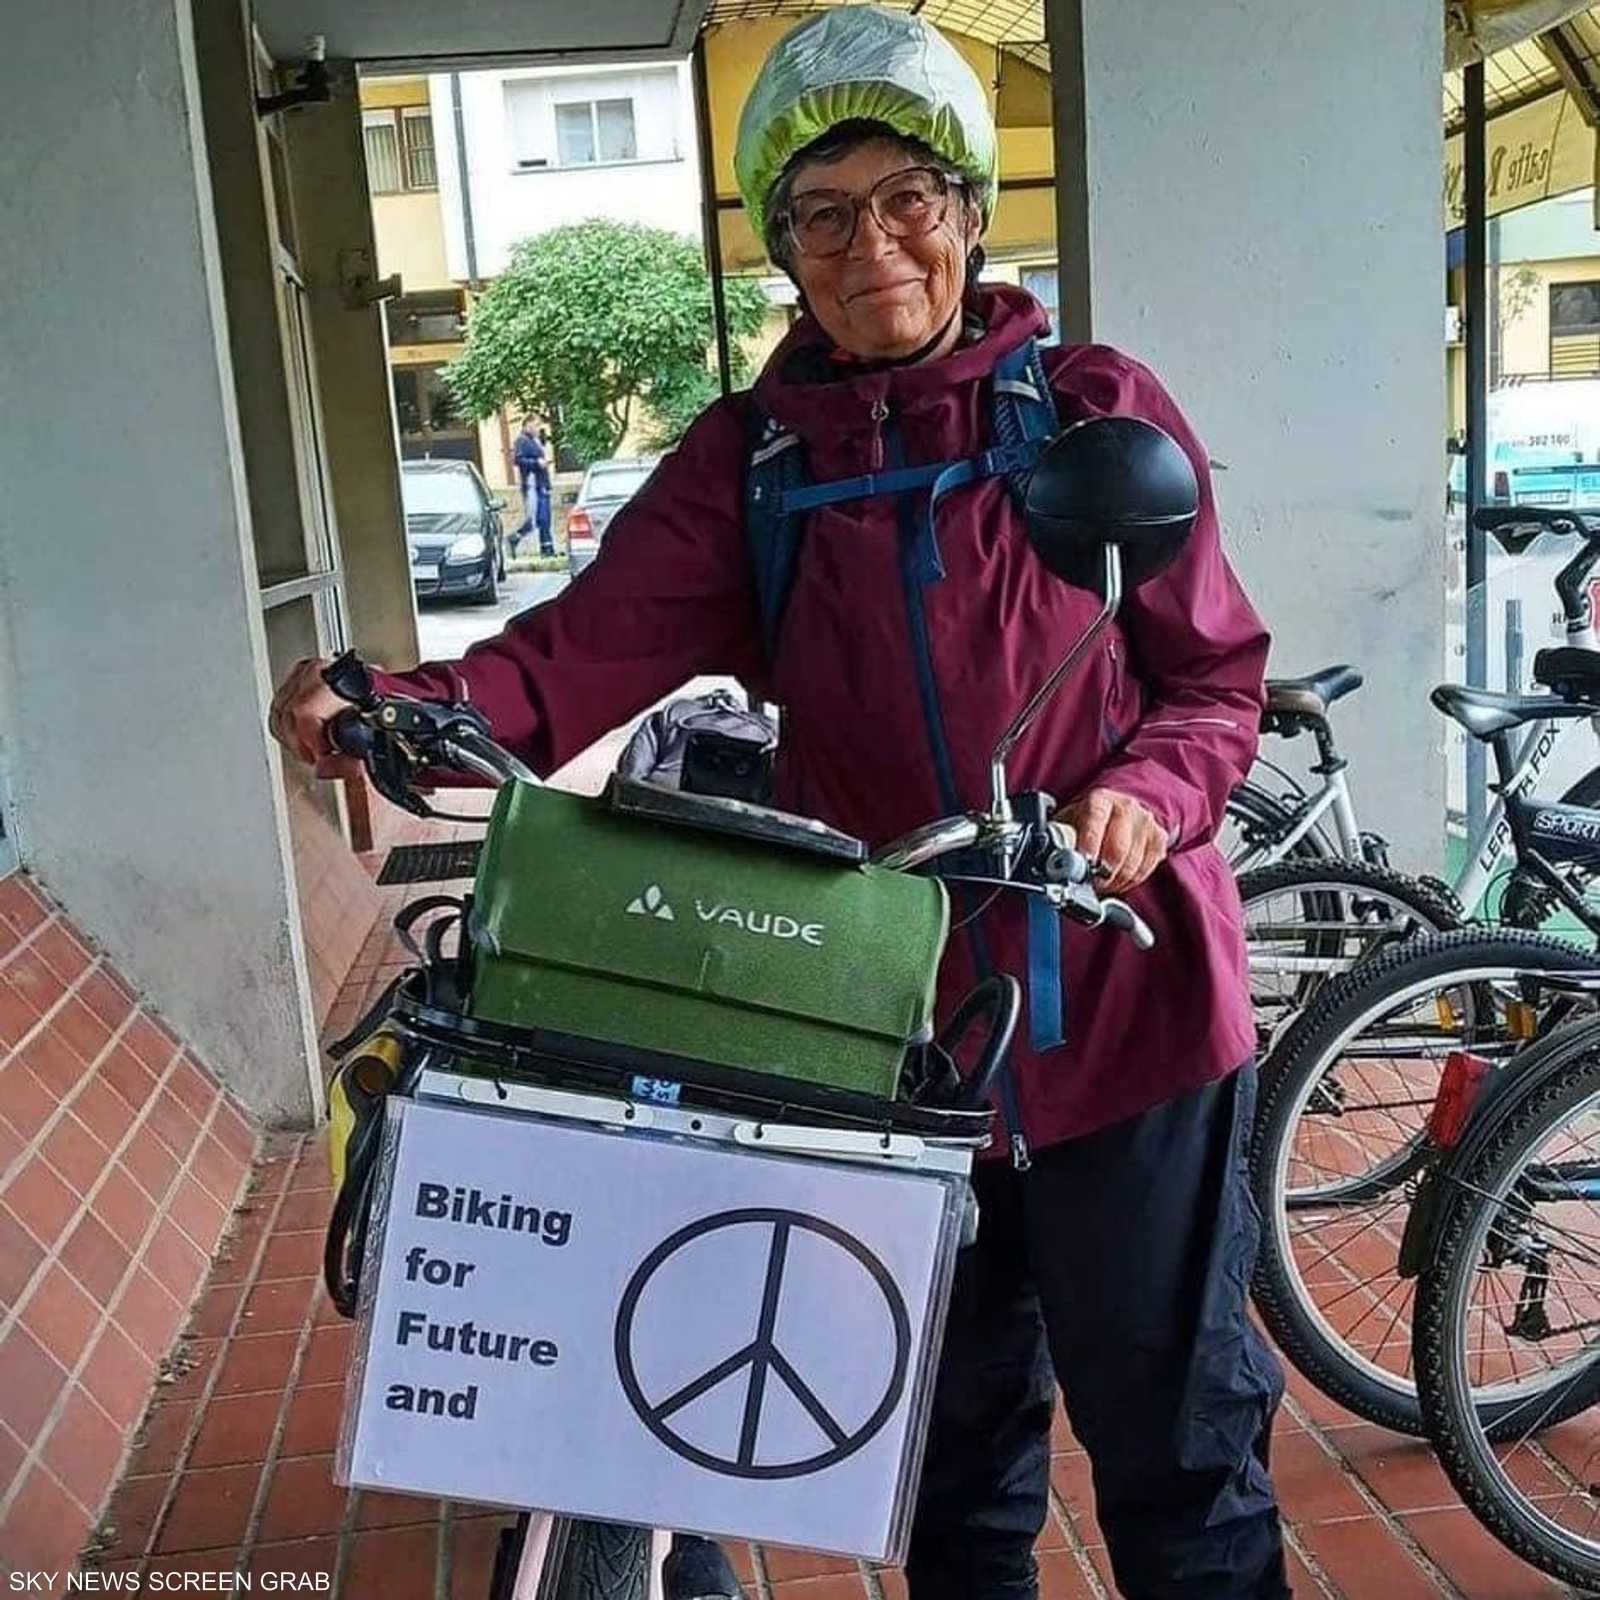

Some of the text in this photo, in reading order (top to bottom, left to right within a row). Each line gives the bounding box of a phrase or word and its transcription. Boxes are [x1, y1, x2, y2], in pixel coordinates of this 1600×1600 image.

[1530, 719, 1561, 775] FOX
[695, 899, 825, 946] VAUDE
[415, 1182, 573, 1247] Biking
[405, 1247, 476, 1288] for
[396, 1311, 559, 1367] Future
[385, 1383, 479, 1420] and
